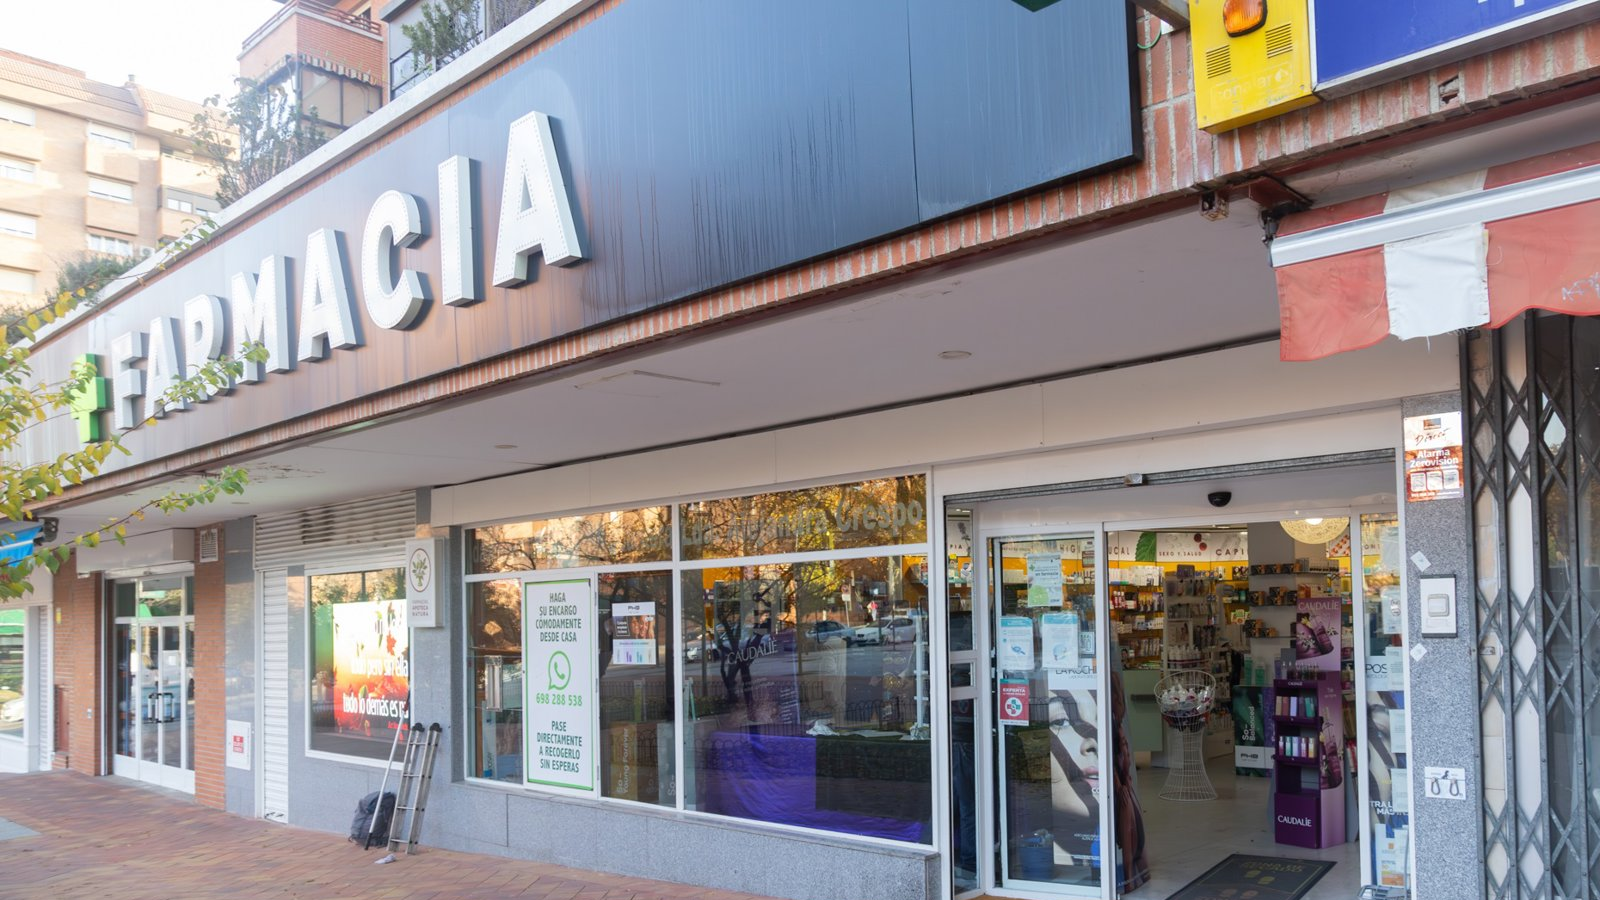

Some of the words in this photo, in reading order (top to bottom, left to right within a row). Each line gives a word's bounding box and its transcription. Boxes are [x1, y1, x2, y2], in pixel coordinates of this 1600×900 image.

[112, 110, 584, 430] FARMACIA
[1417, 448, 1450, 459] Alarma
[1410, 456, 1459, 468] Zerovision
[836, 498, 923, 537] Crespo
[550, 592, 566, 602] HAGA
[539, 606, 548, 616] SU
[549, 605, 577, 616] ENCARGO
[540, 632, 560, 642] DESDE
[561, 632, 577, 642] CASA
[343, 691, 358, 713] todo
[389, 699, 399, 718] es
[536, 693, 550, 704] 698
[552, 694, 566, 705] 288
[568, 695, 583, 706] 538
[551, 721, 567, 732] PASE
[1248, 706, 1256, 741] Balanced
[537, 732, 583, 747] DIRECTAMENTE
[539, 746, 544, 756] A
[545, 746, 581, 760] RECOGERLO
[540, 759, 551, 769] SIN
[552, 760, 580, 773] ESPERAS
